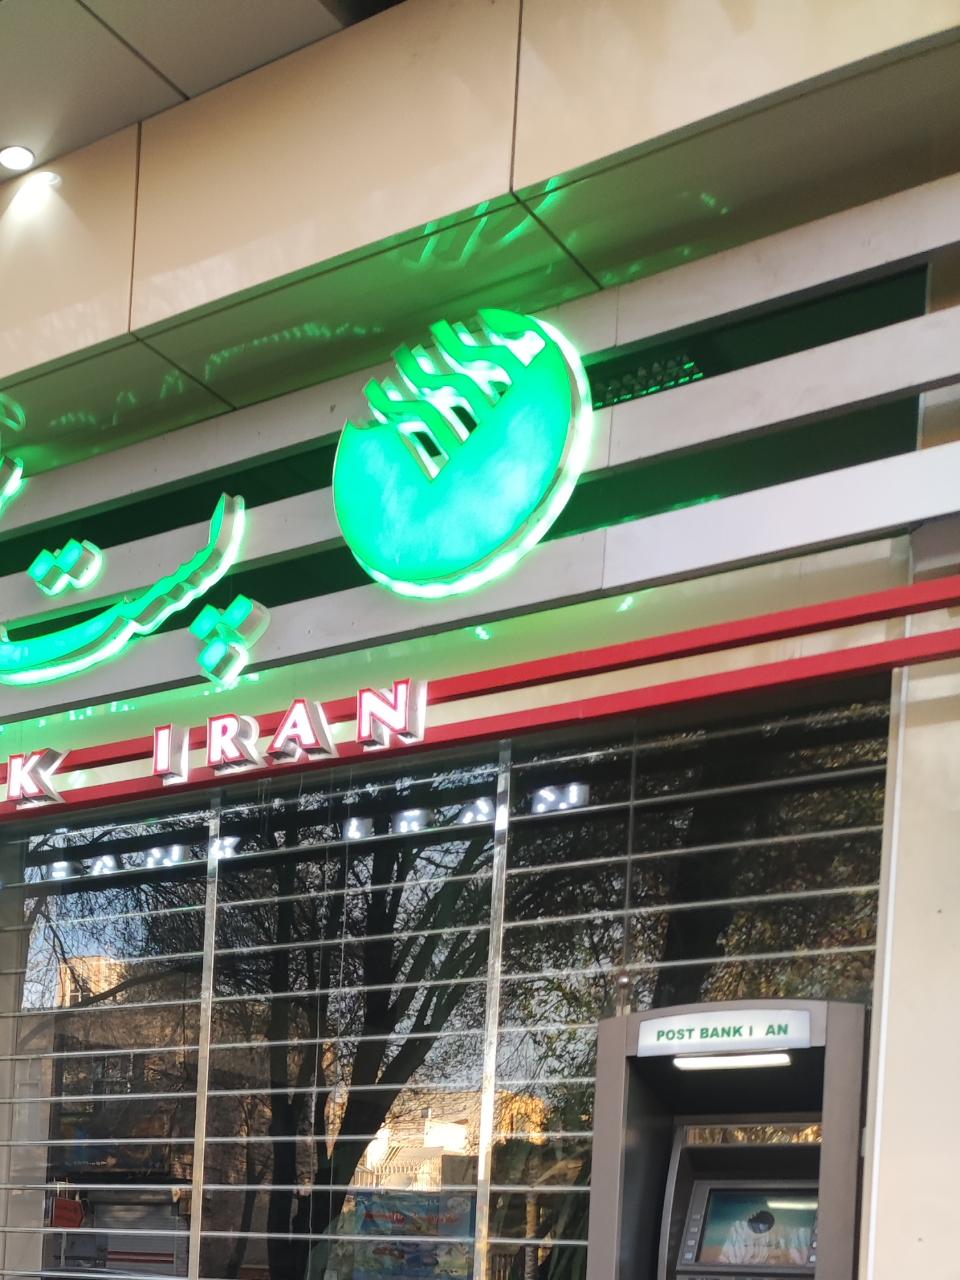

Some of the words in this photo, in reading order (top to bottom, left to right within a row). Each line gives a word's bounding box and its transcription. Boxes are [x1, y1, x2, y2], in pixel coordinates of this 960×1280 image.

[152, 678, 428, 785] IRAN
[656, 1028, 695, 1042] POST
[699, 1026, 743, 1039] BANK
